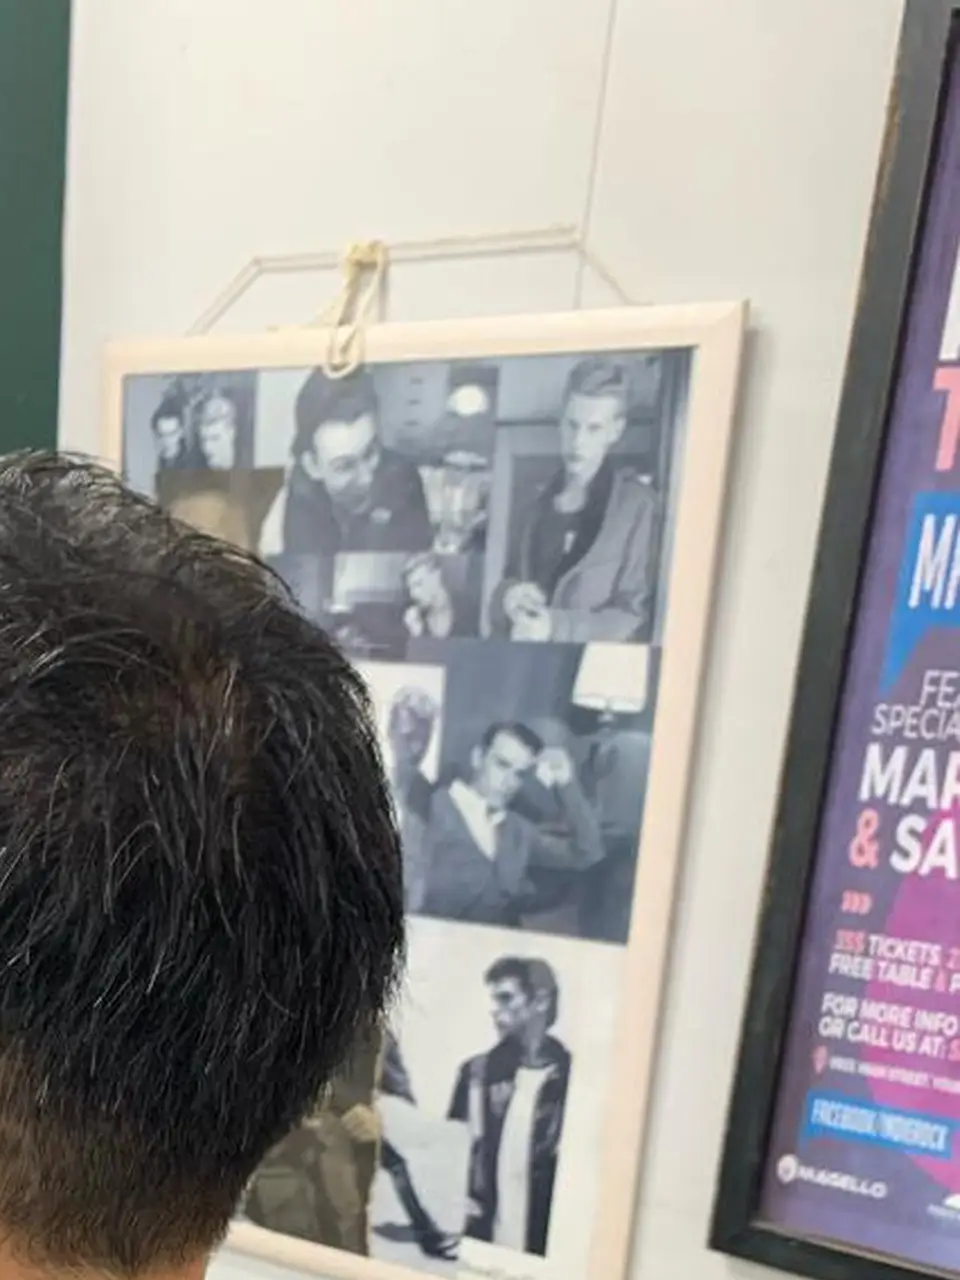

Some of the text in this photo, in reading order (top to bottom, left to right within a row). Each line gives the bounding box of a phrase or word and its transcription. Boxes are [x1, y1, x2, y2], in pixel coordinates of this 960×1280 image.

[919, 669, 960, 709] FE
[850, 807, 958, 880] & SA
[868, 933, 942, 967] TICKETS
[828, 951, 874, 981] FREE
[877, 960, 934, 990] TABLE
[820, 991, 959, 1037] FOR MORE INFO
[818, 1016, 845, 1039] OR
[847, 1021, 889, 1047] CALL
[891, 1029, 917, 1054] US
